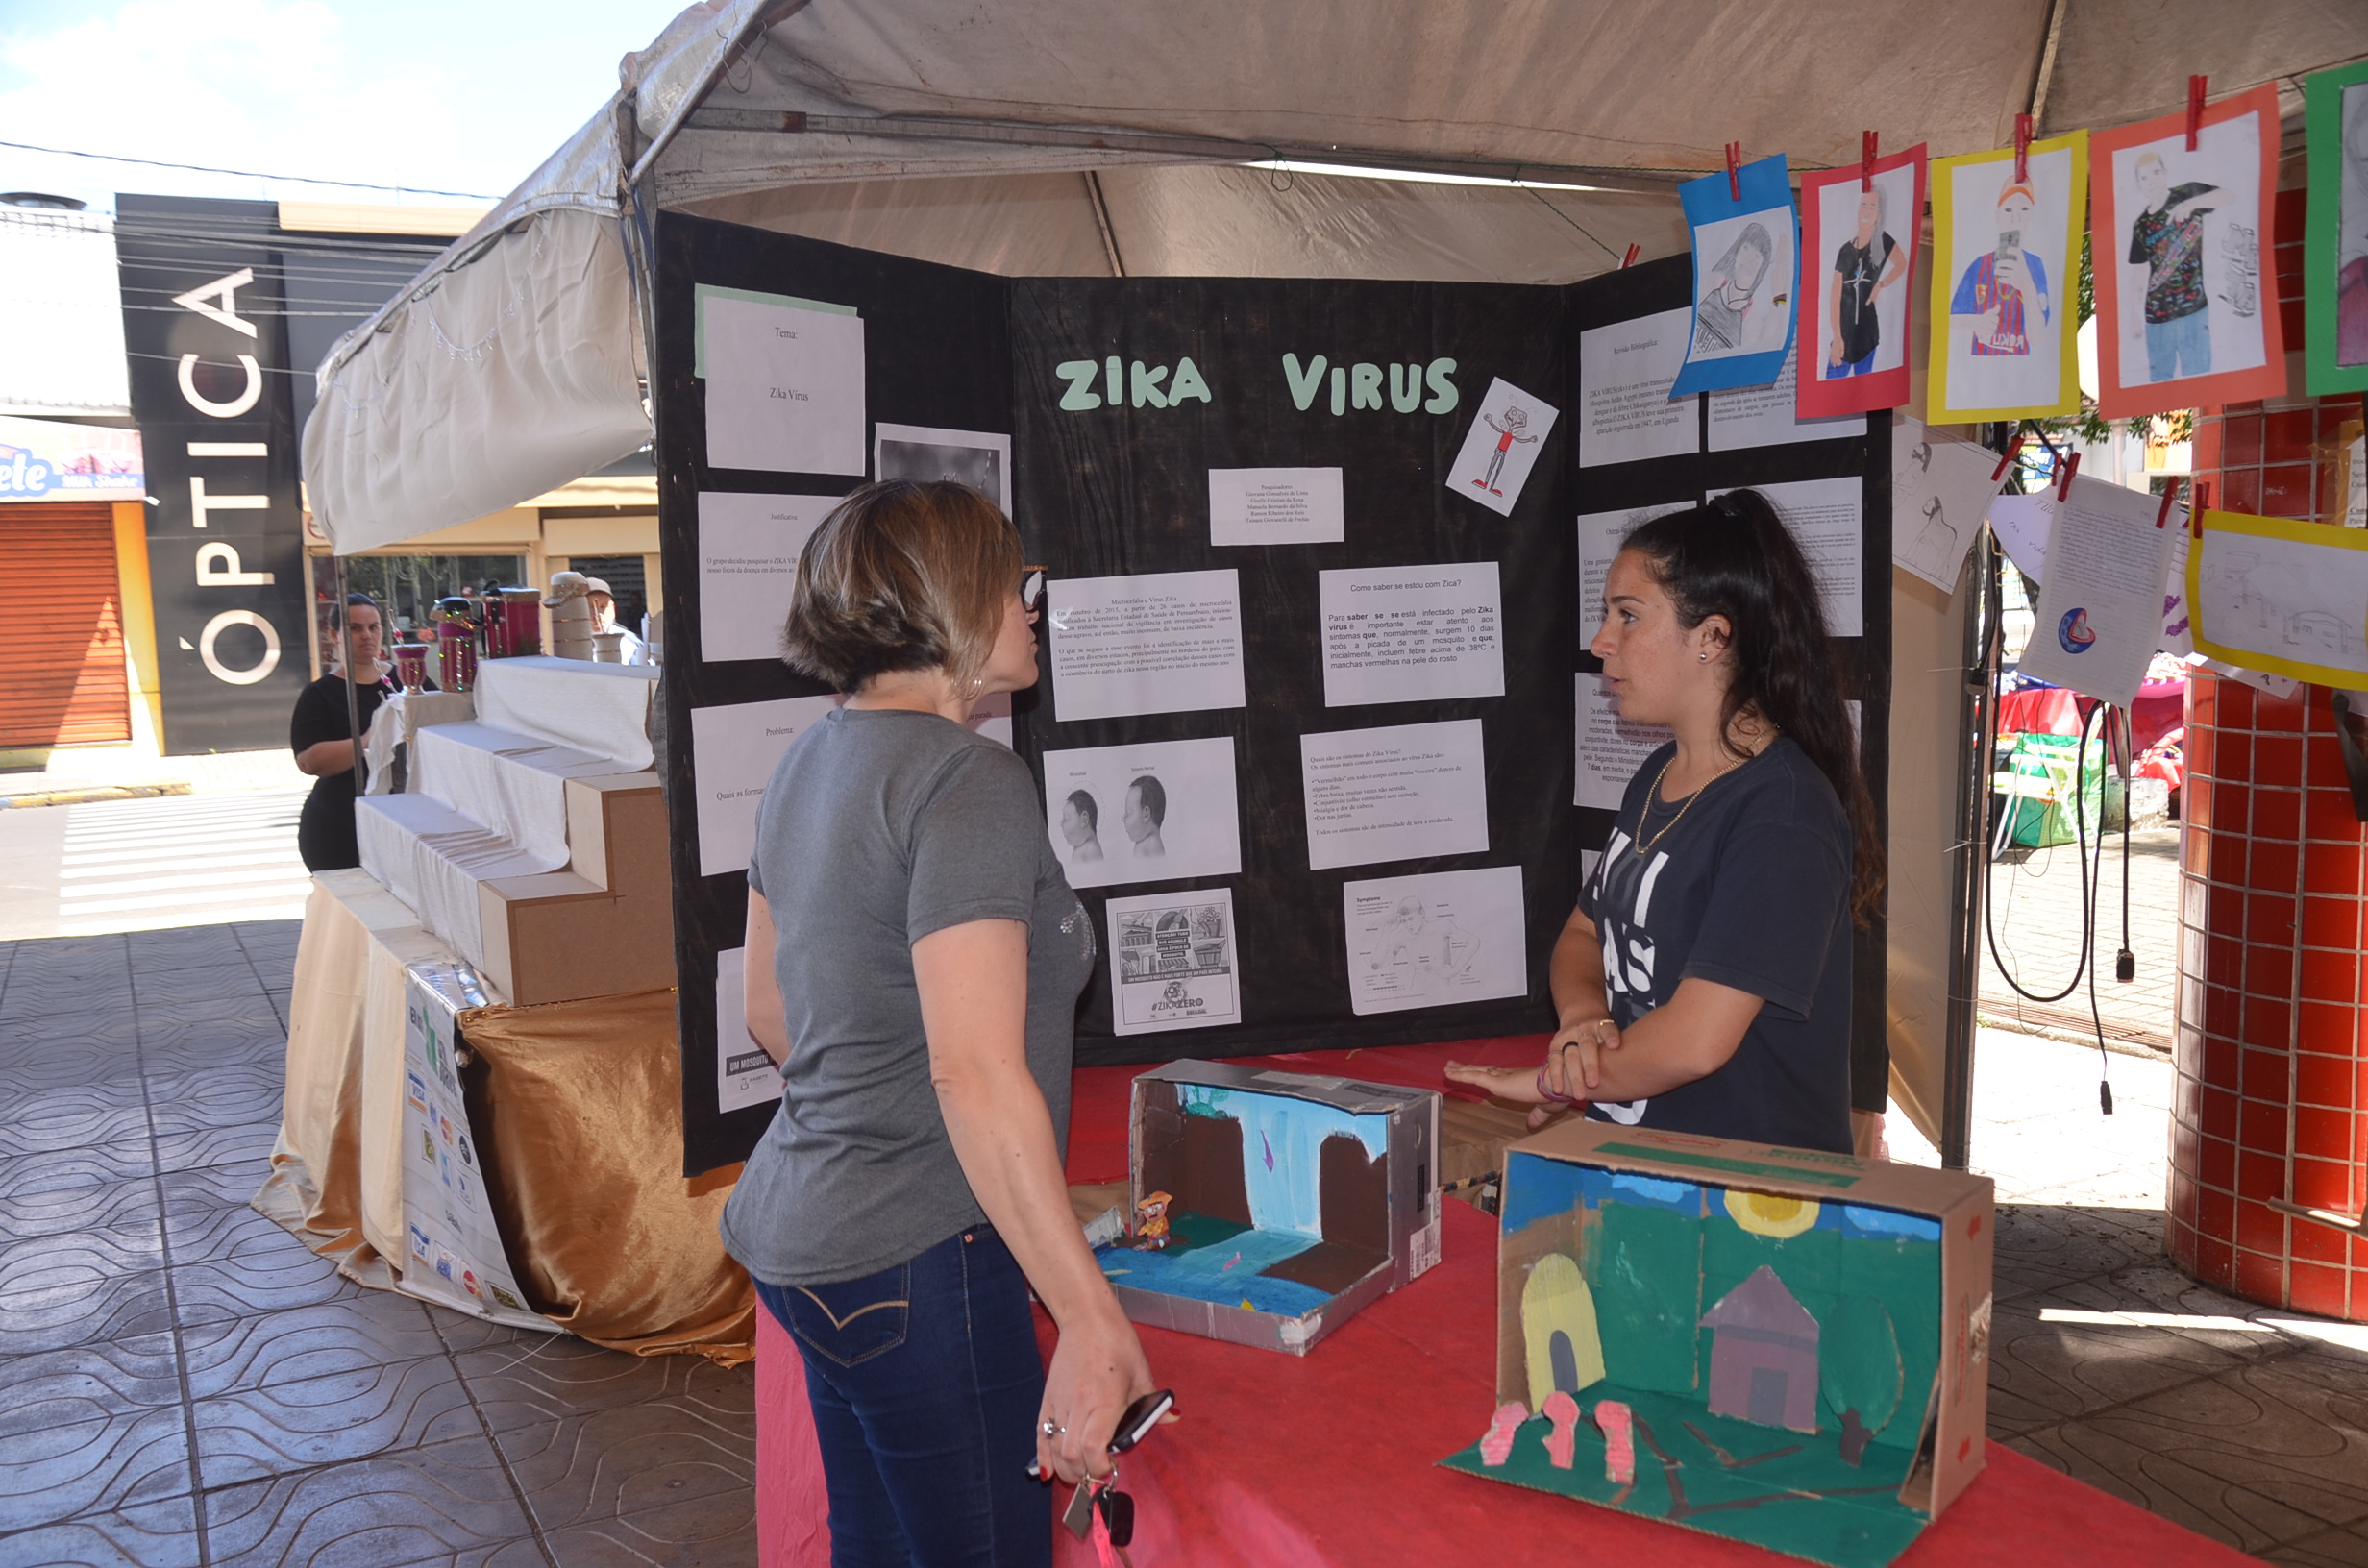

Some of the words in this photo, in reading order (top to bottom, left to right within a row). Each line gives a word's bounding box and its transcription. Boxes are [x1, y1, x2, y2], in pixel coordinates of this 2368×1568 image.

[775, 327, 798, 339] Tema:
[1055, 355, 1212, 410] ZIKA
[1282, 353, 1459, 416] VIRUS
[770, 388, 786, 399] Zika
[172, 266, 281, 686] ÓPTICA
[1422, 607, 1454, 616] infectado
[1461, 606, 1476, 616] pelo
[1368, 620, 1404, 630] importante
[1446, 616, 1468, 625] atento
[1329, 631, 1361, 640] sintomas
[1384, 627, 1430, 639] normalmente,
[1435, 627, 1462, 636] surgem
[1330, 642, 1347, 650] após
[1367, 639, 1390, 649] picada
[1433, 635, 1465, 646] mosquito
[1331, 649, 1373, 660] inicialmente,
[1378, 648, 1404, 656] incluem
[1430, 645, 1451, 653] acima
[1365, 658, 1400, 667] vermelhas
[1412, 656, 1426, 666] pele
[766, 727, 795, 736] Problema:
[716, 789, 735, 800] Quais
[1151, 998, 1204, 1011] #ZIKAZERO
[729, 1061, 740, 1071] UM
